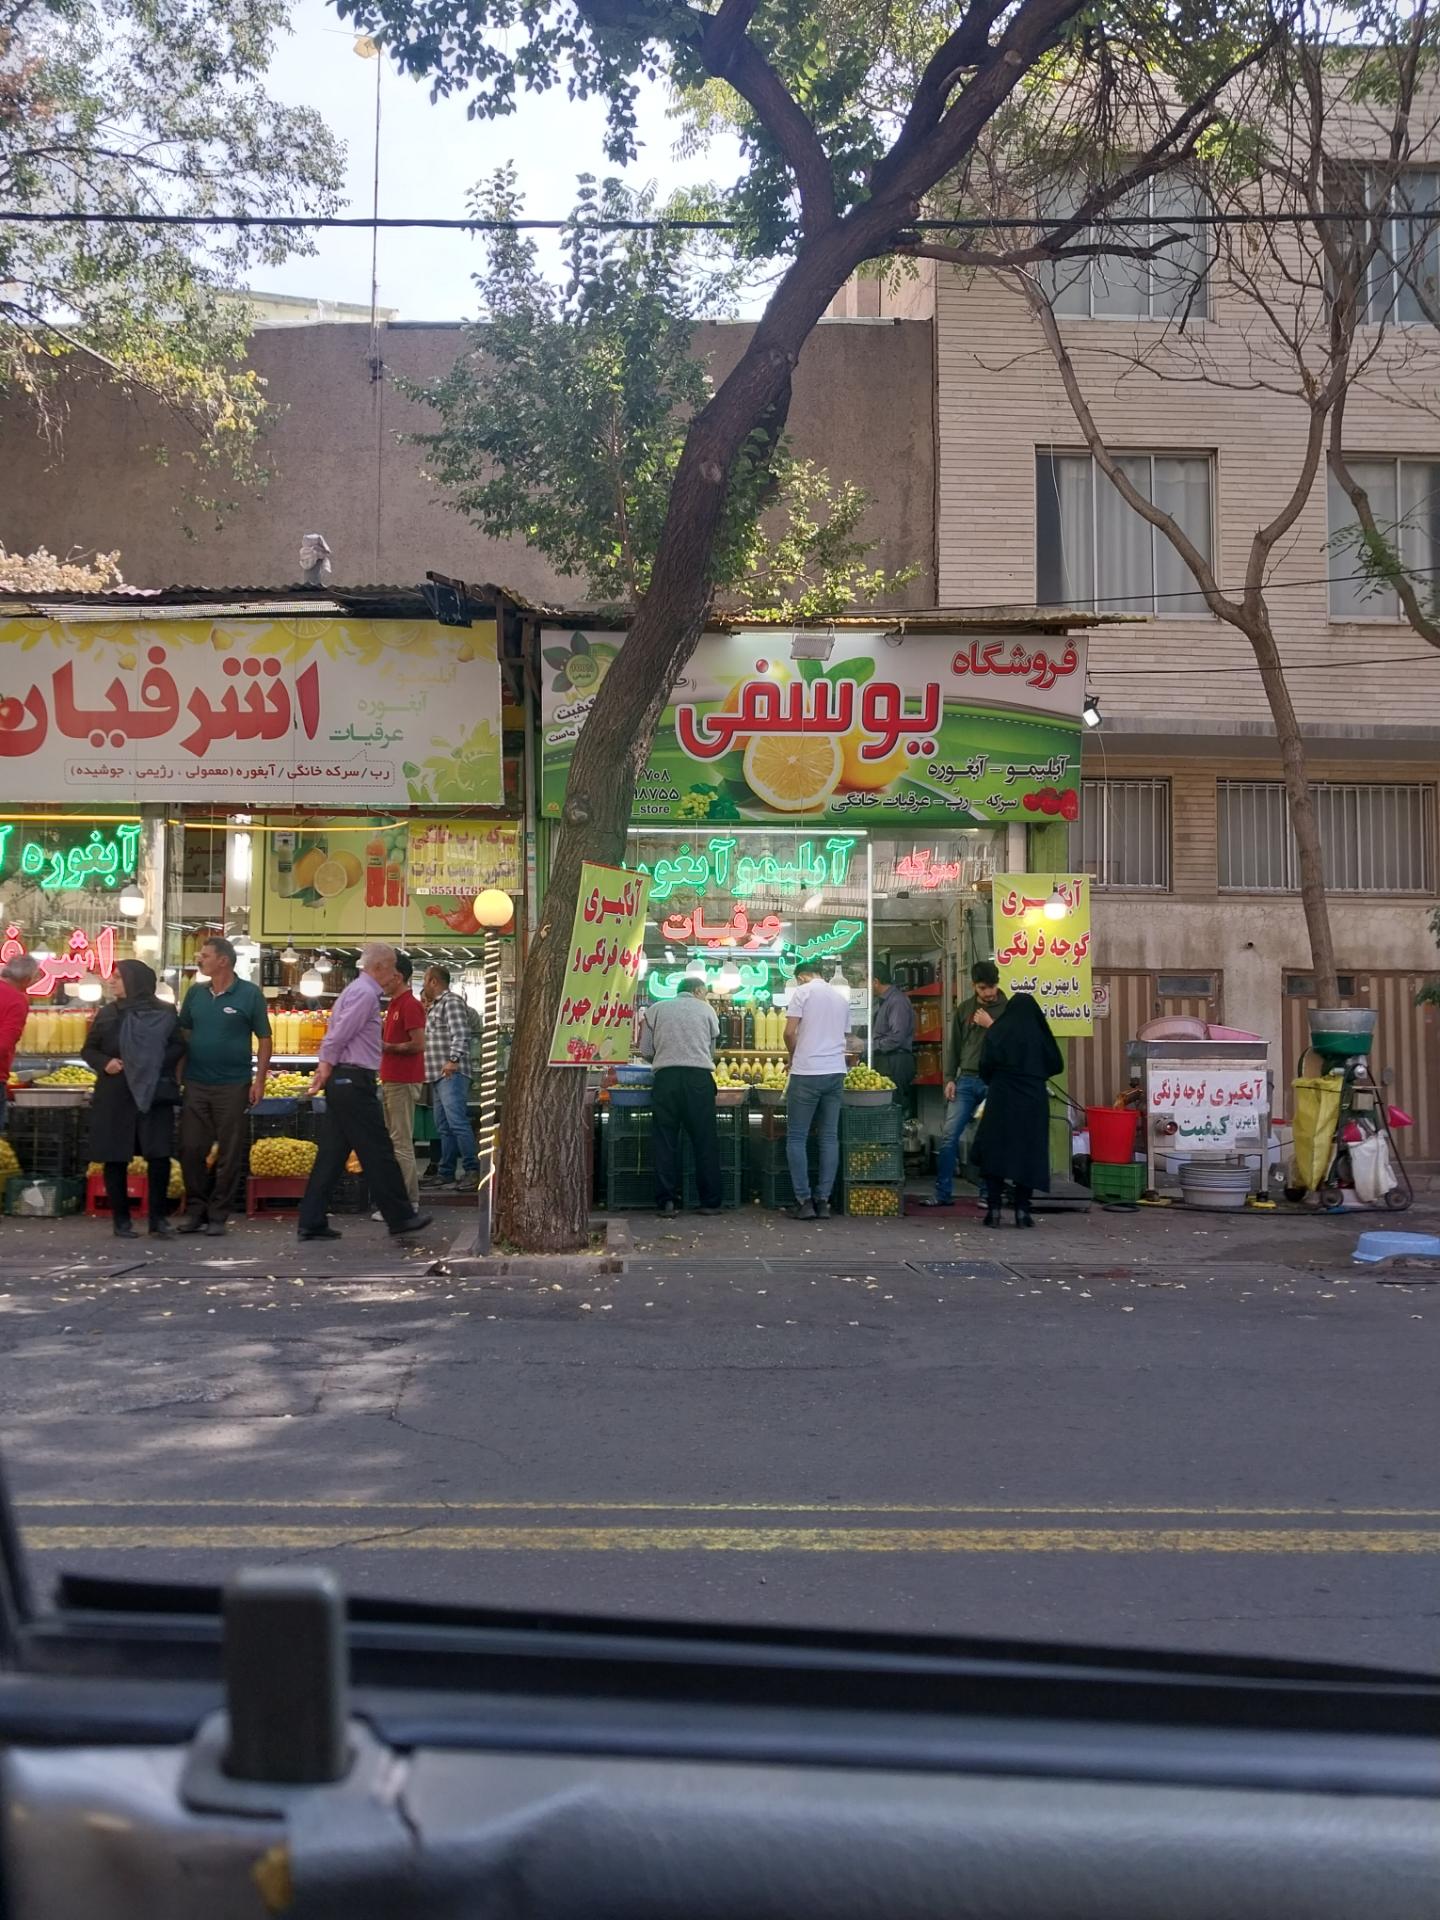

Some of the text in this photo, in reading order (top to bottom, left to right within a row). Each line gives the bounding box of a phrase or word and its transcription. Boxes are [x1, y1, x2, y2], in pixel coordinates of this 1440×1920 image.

[952, 640, 1078, 689] فروشگاه
[0, 646, 320, 758] اشرفیان
[357, 690, 429, 720] آبغوره
[680, 659, 940, 759] یوسفی
[328, 721, 405, 749] عرقیات
[136, 764, 174, 780] رژیمی
[236, 764, 276, 780] آبغوره
[286, 764, 323, 780] خانگی
[325, 766, 360, 781] سرکه
[371, 766, 390, 780] رب
[644, 768, 670, 781] ۷۰۸
[927, 755, 988, 783] آبغوره
[1005, 756, 1069, 783] آبلیمو
[632, 804, 670, 816] _store
[831, 792, 880, 813] خانگی
[882, 792, 930, 813] عرقیات
[986, 794, 1018, 812] سرکه
[22, 824, 142, 888] آبغوره
[621, 838, 854, 898] آبلیمو آبغو
[896, 849, 960, 888] سرکه
[584, 879, 643, 926] آبگیری
[1002, 879, 1082, 916] آبگری
[662, 903, 783, 948] عرقیات
[0, 926, 114, 995] اشرف
[573, 938, 642, 977] گوجه فرنگی و
[996, 929, 1089, 966] گوجه فرنگی
[1010, 976, 1079, 996] با بهترین کیفیت
[561, 992, 634, 1028] یموترش جهرم
[1050, 1003, 1080, 1018] دستگاه
[1083, 1003, 1091, 1023] با
[1153, 1077, 1263, 1107] آبگیری گوجه فرنگی
[1179, 1115, 1230, 1142] کیفیت
